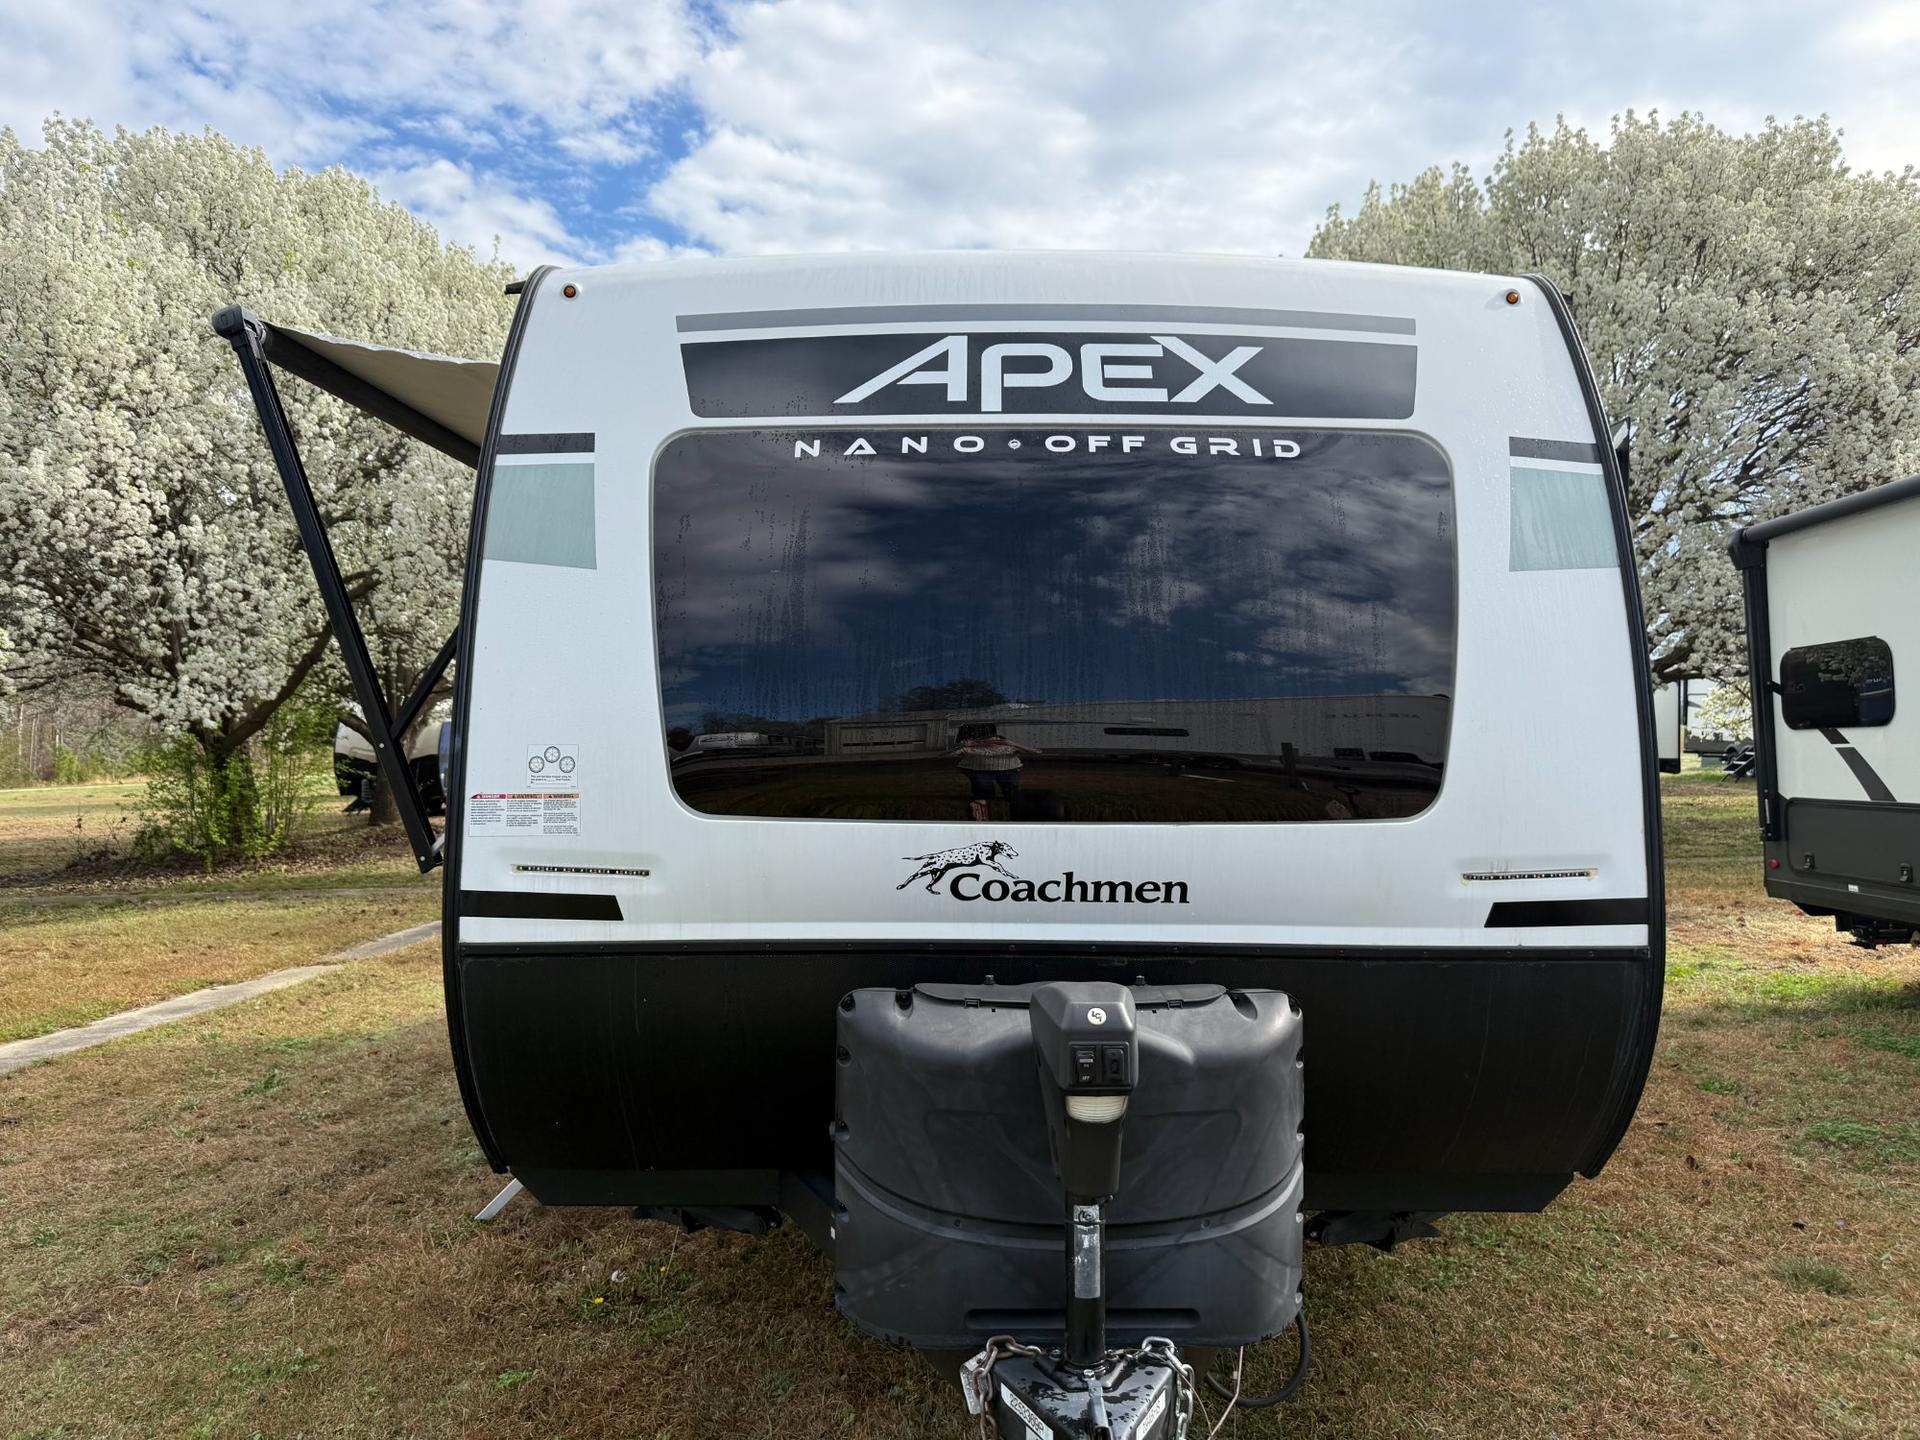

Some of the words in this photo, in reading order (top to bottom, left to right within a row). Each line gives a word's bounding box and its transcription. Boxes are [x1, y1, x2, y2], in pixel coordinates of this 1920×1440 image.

[832, 335, 1274, 412] APEX
[794, 435, 985, 458] NANO
[1044, 435, 1145, 453] OFF
[1169, 436, 1301, 458] GRID
[949, 871, 1190, 904] Coachmen
